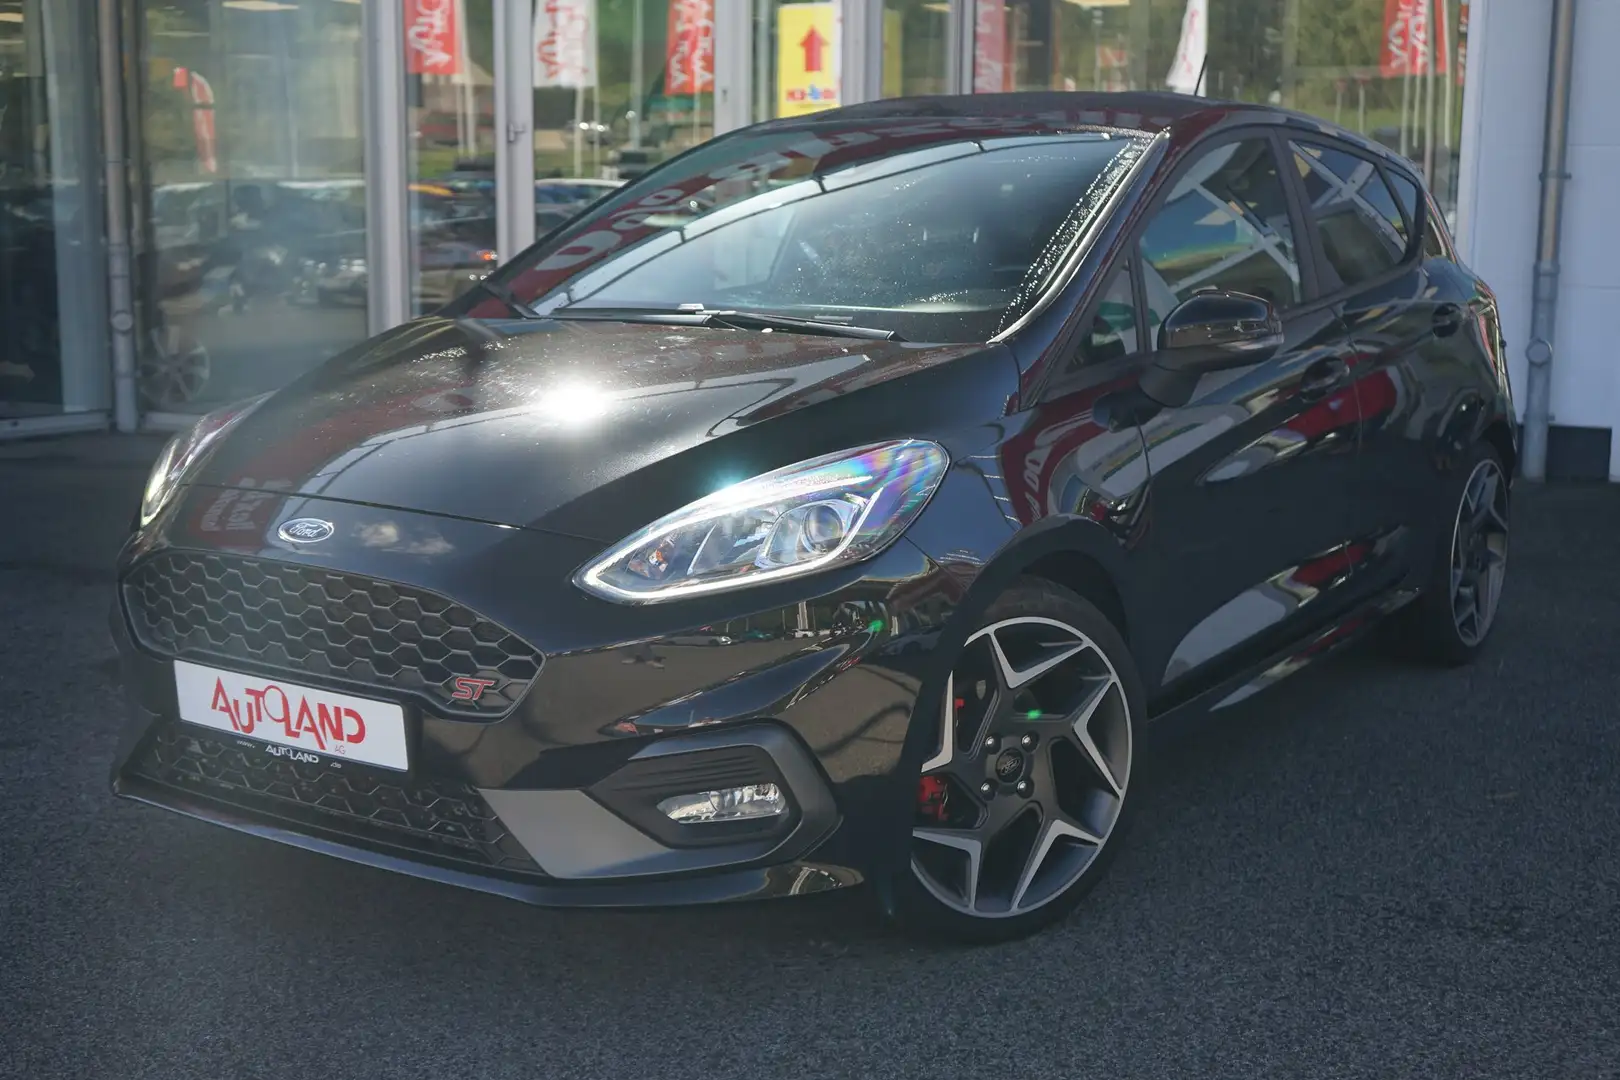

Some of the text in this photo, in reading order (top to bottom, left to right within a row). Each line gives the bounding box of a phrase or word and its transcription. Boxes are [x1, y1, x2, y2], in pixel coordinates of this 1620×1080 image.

[288, 521, 324, 538] Ford
[451, 677, 495, 701] ST
[211, 676, 366, 750] AUTOLAND
[265, 744, 320, 763] AUTOLAND
[334, 744, 346, 755] AG
